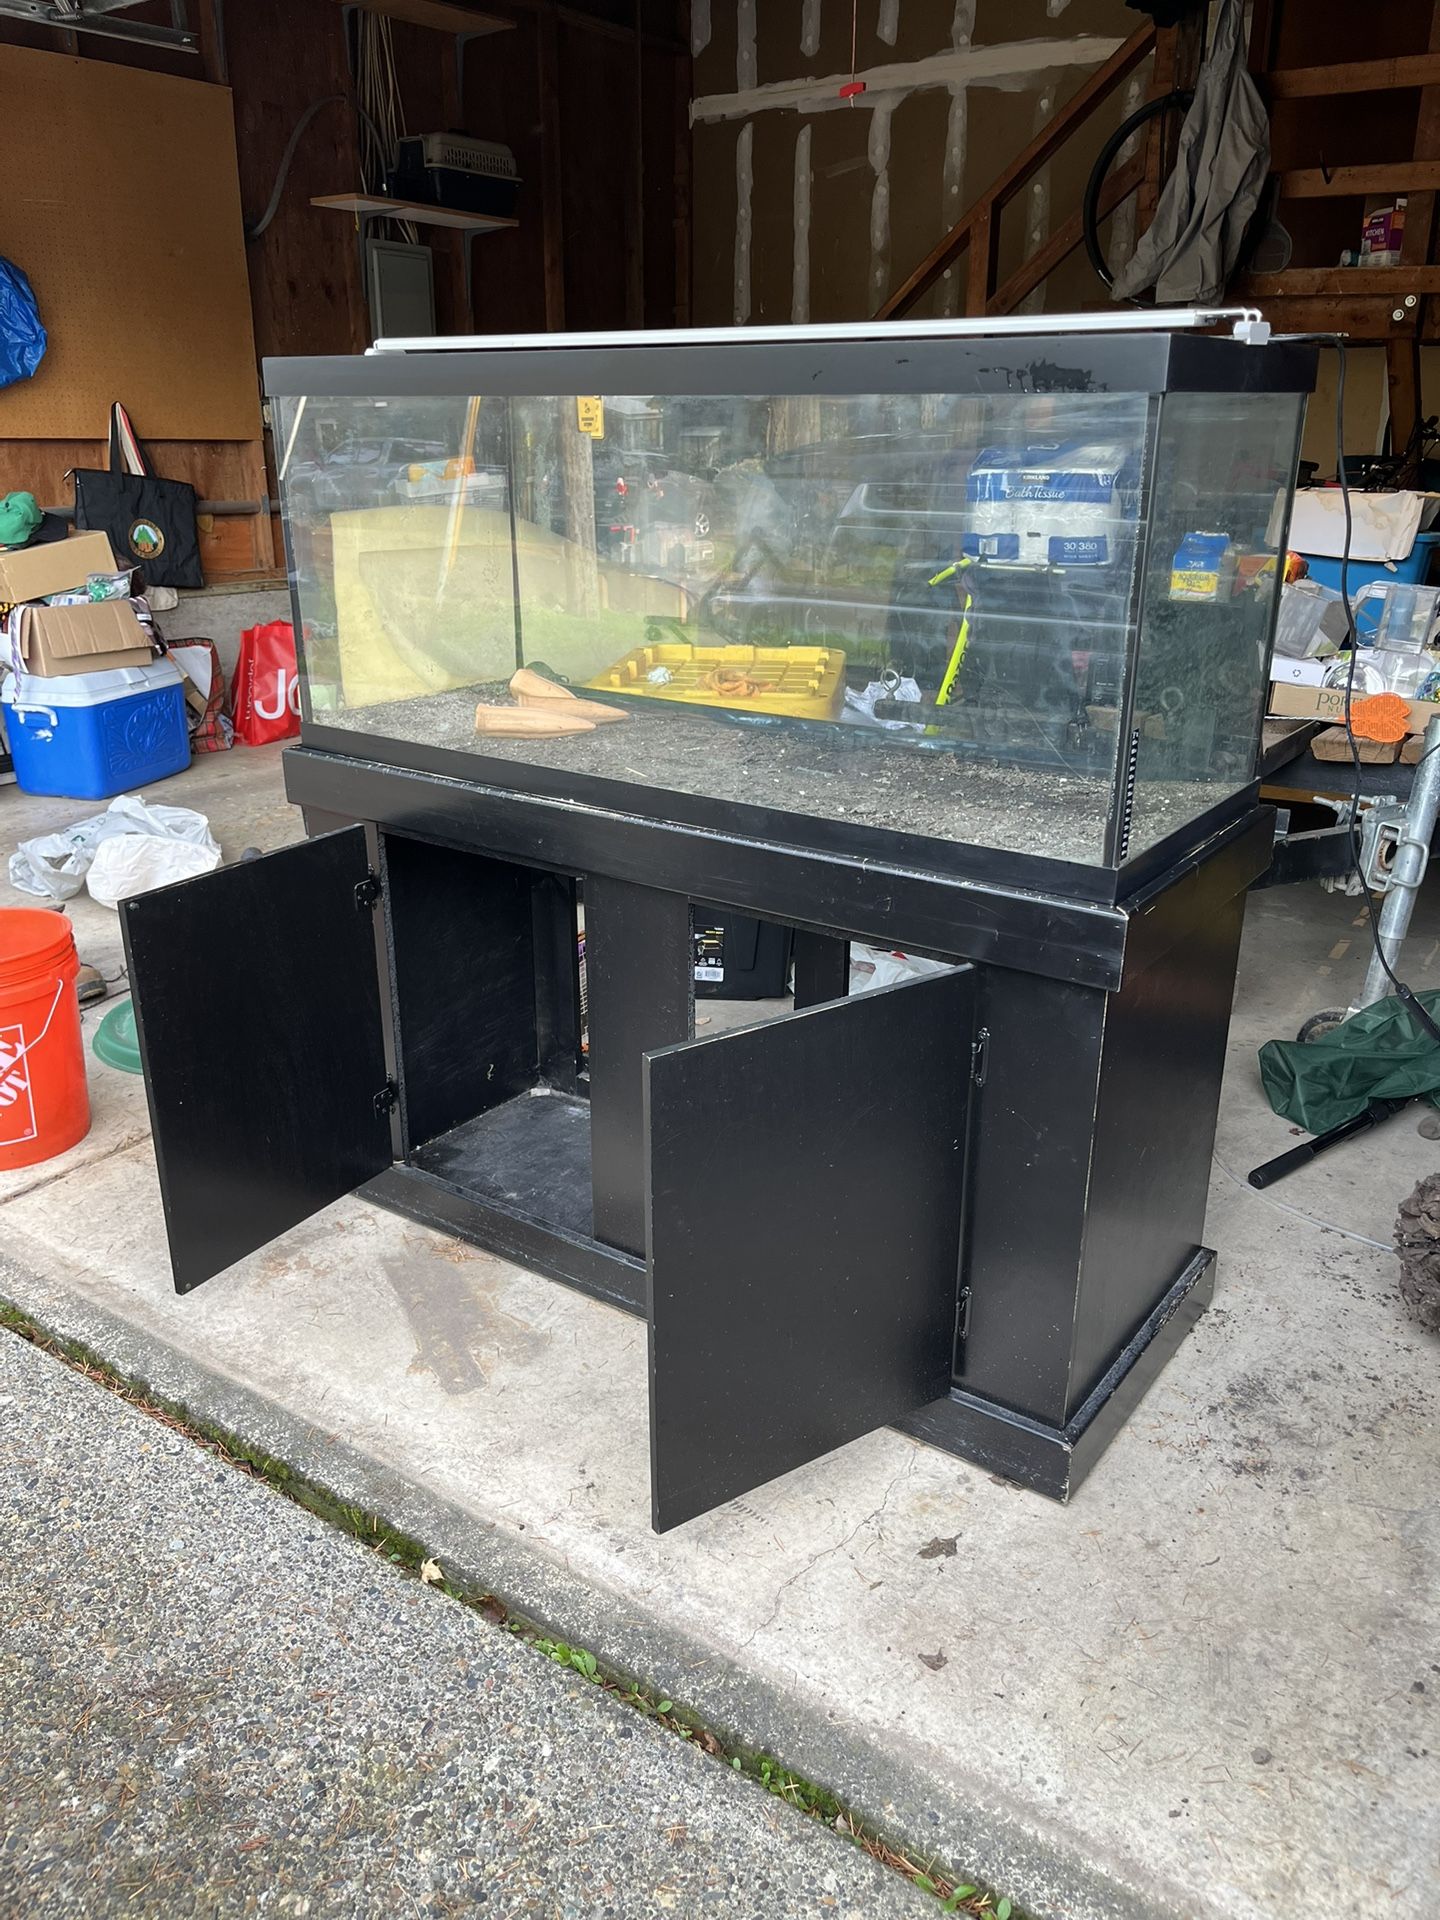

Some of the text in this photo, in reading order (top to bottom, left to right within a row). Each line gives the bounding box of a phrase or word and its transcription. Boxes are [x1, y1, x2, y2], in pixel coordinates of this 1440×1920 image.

[1005, 485, 1066, 499] Bath Tissue
[1063, 541, 1098, 551] 30 380
